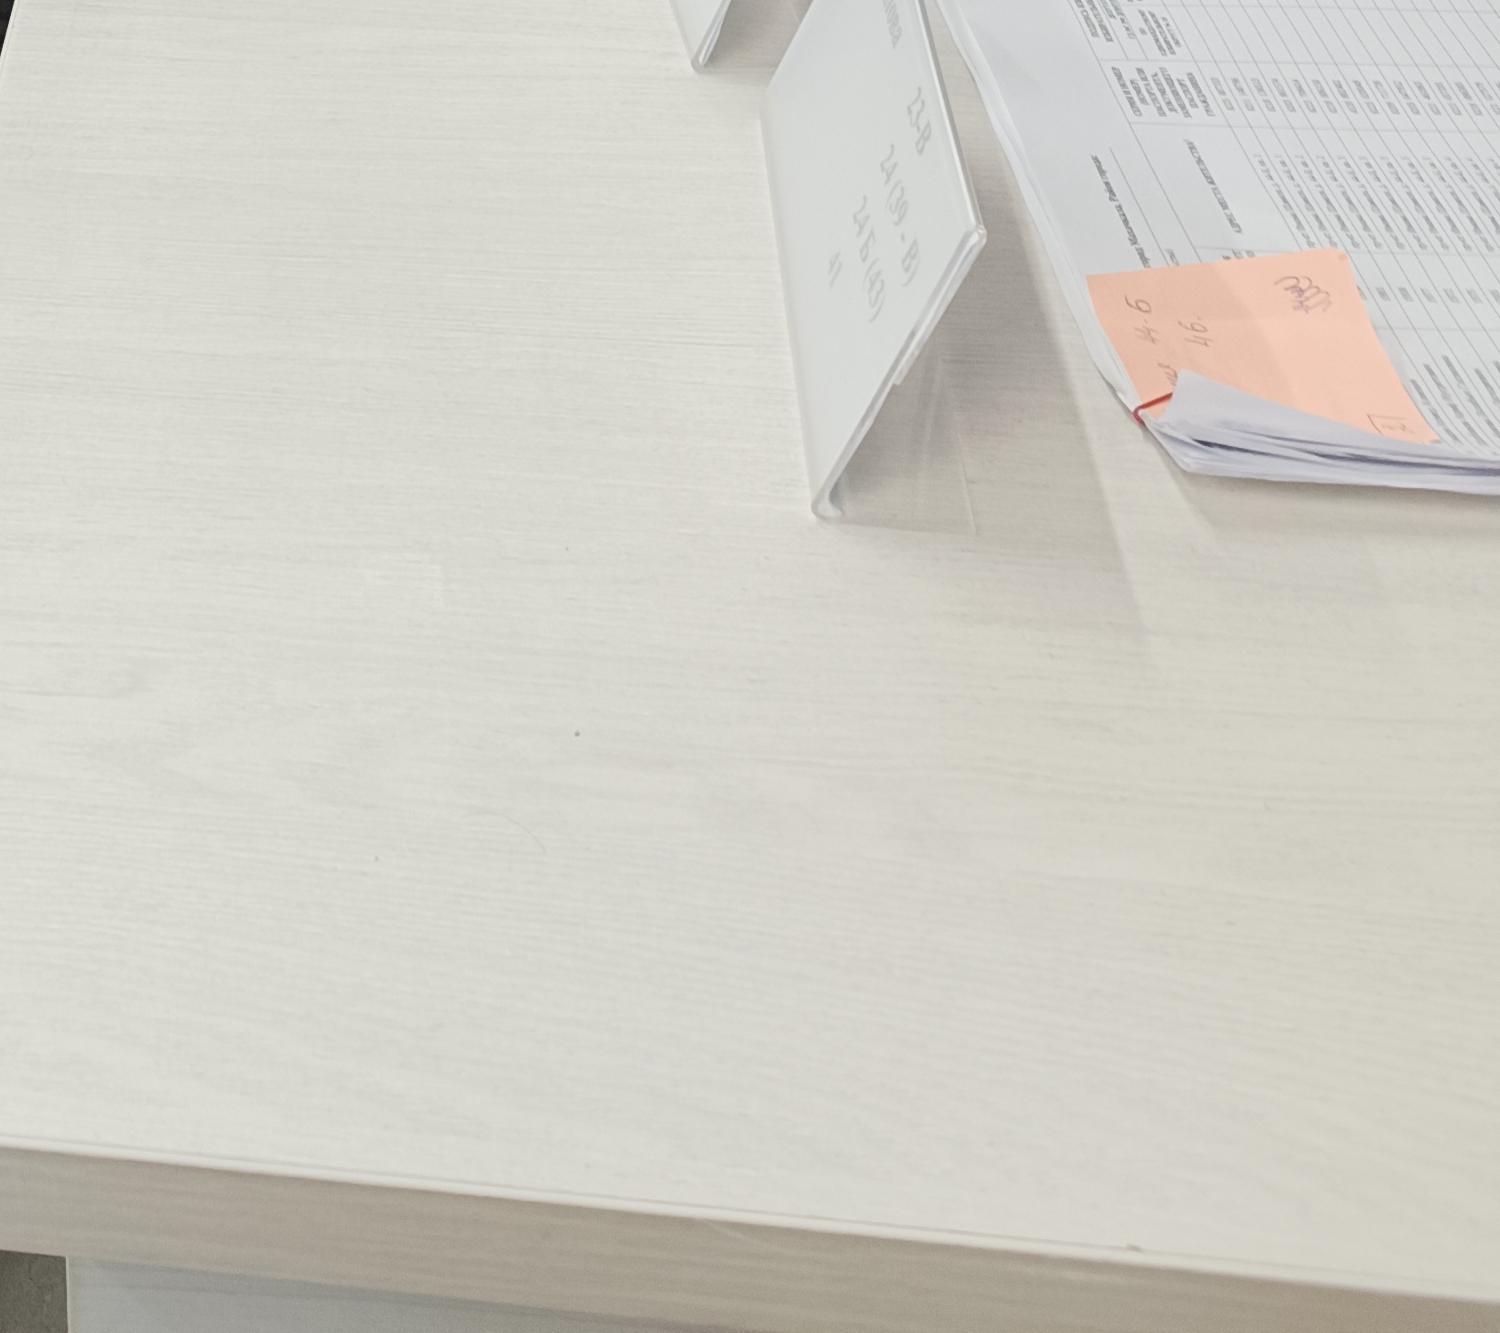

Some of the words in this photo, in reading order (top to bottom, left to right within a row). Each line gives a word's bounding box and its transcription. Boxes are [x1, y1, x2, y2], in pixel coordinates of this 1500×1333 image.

[906, 87, 932, 155] 23-В
[879, 143, 899, 178] 24
[1184, 139, 1216, 186] ЖИТЕЛЬСТВА
[1211, 187, 1230, 211] МЕСТА
[1224, 212, 1243, 234] АДРЕС
